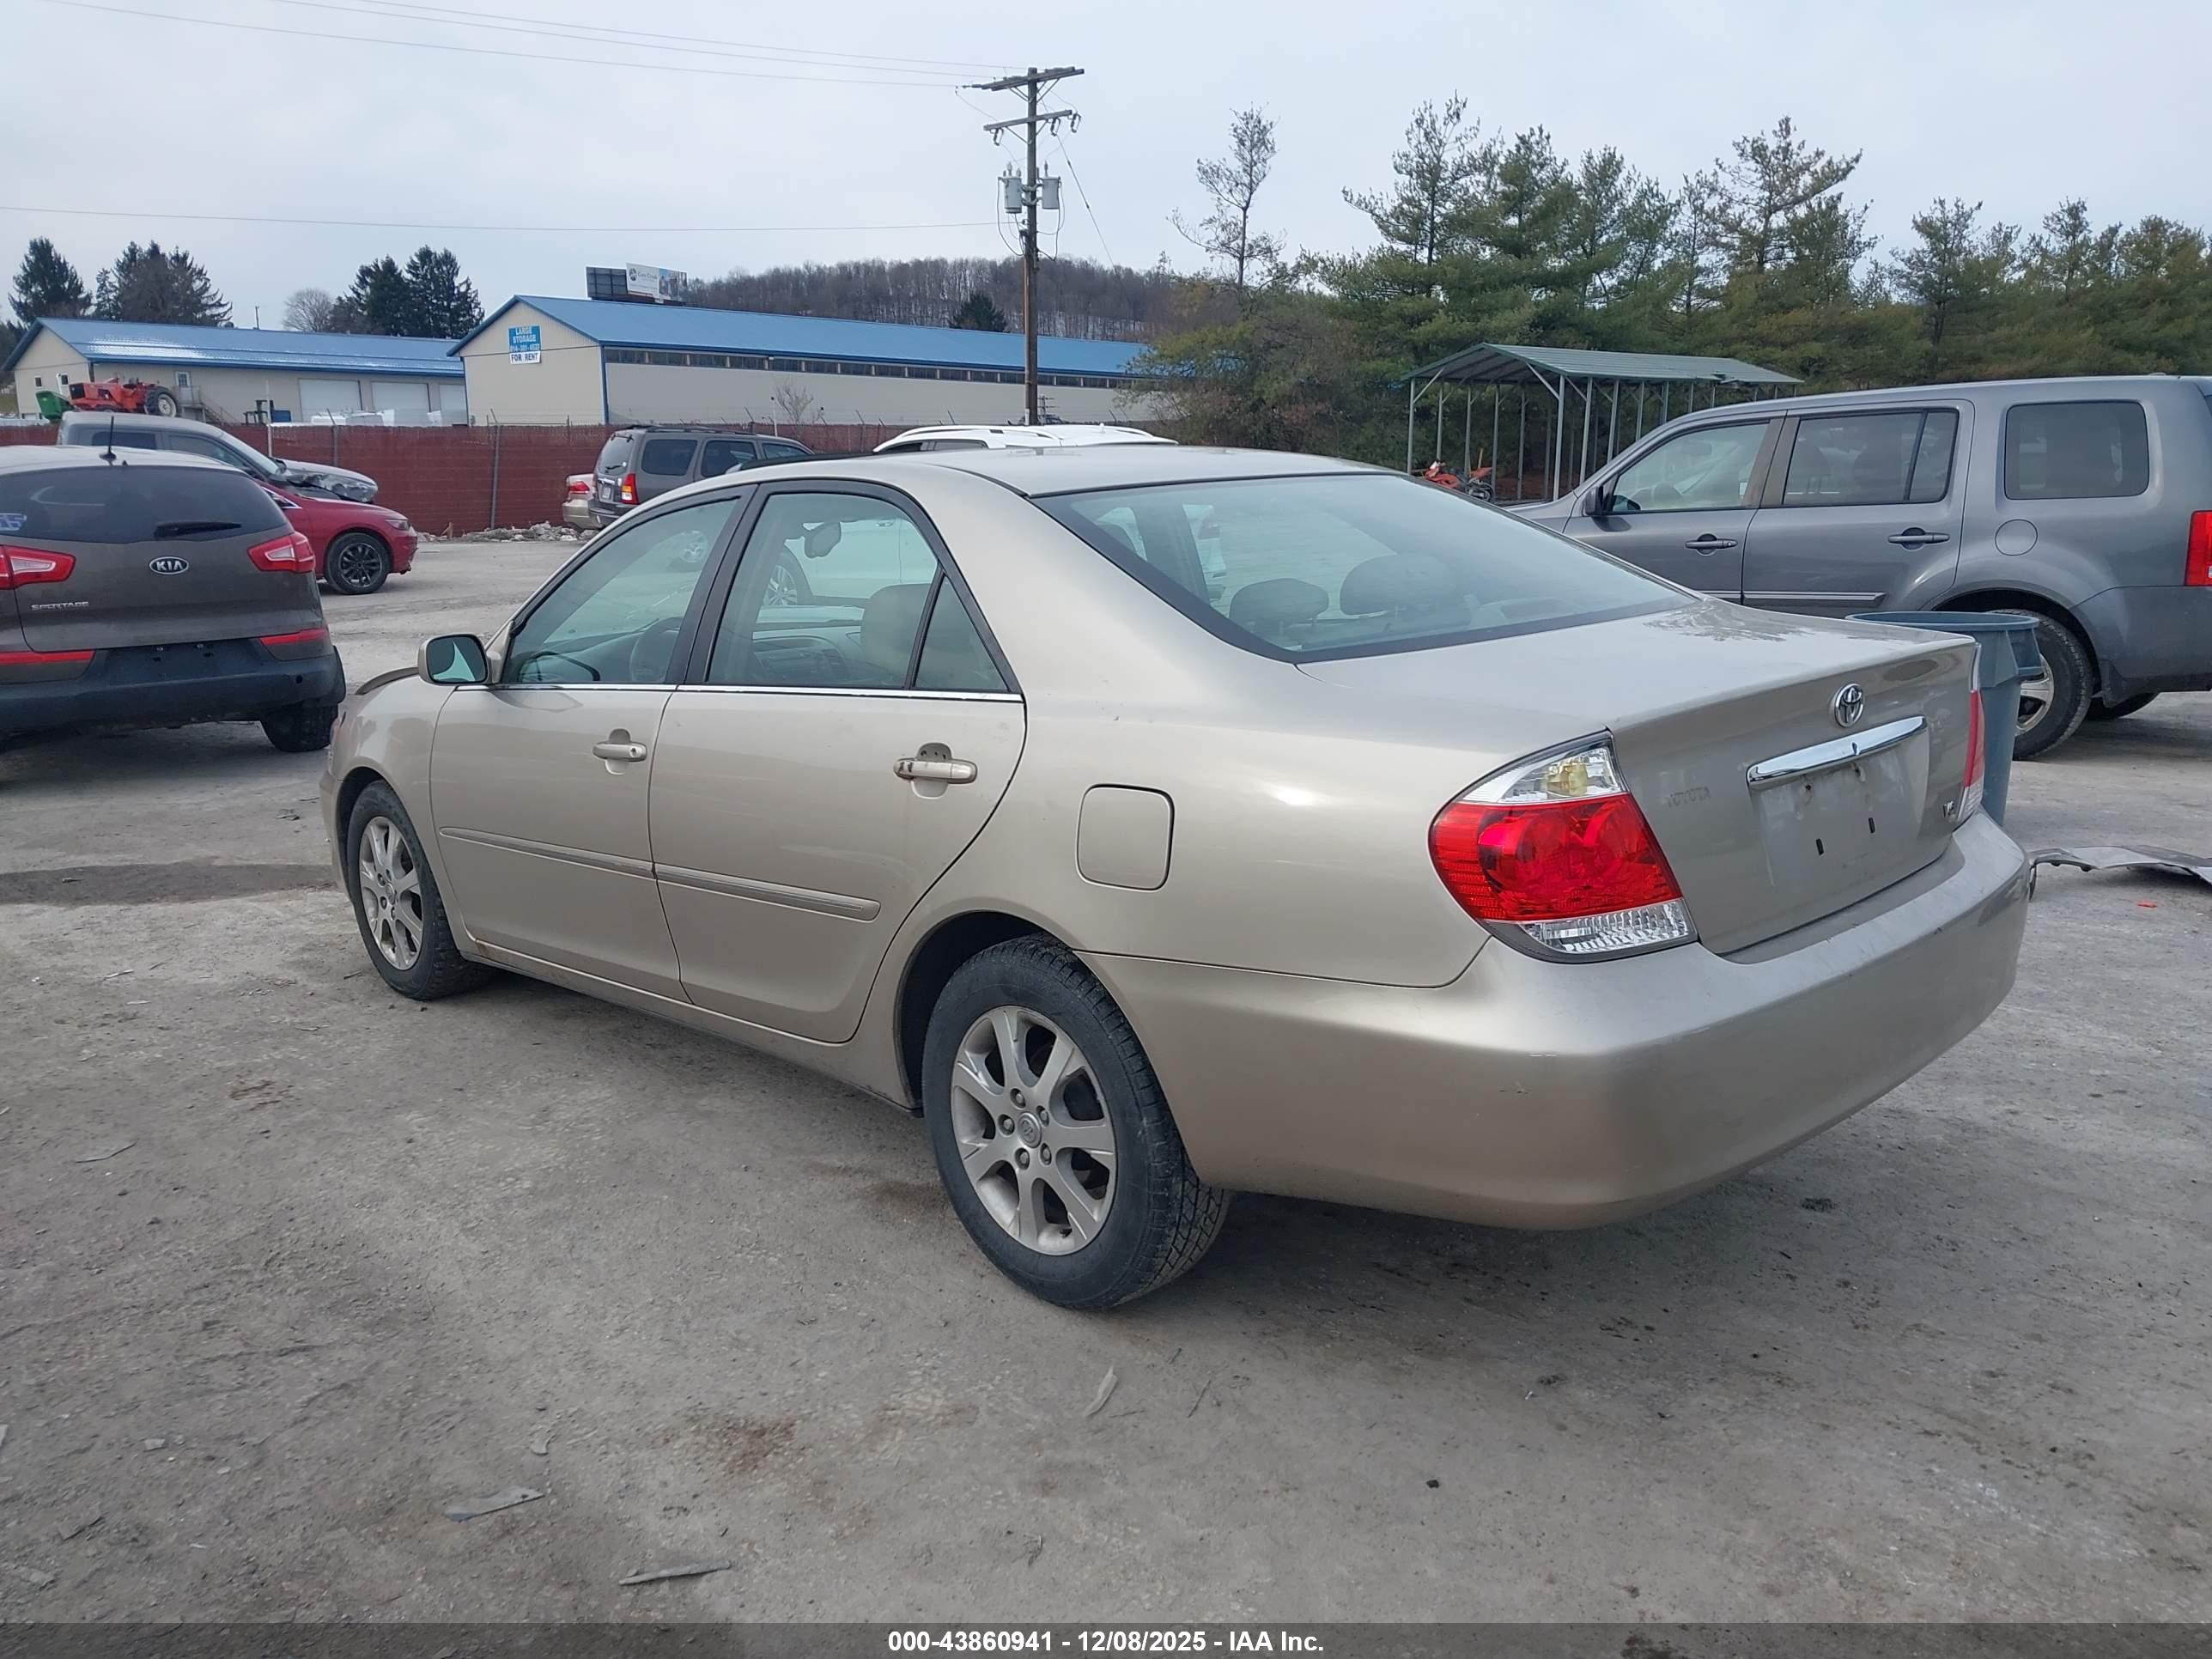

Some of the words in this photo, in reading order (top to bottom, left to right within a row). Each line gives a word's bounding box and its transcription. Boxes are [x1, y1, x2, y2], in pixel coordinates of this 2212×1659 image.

[513, 334, 537, 343] STORAGE
[511, 353, 522, 362] FOR
[525, 352, 538, 361] RENT
[156, 561, 184, 571] KIA
[31, 601, 89, 611] SPORTAGE
